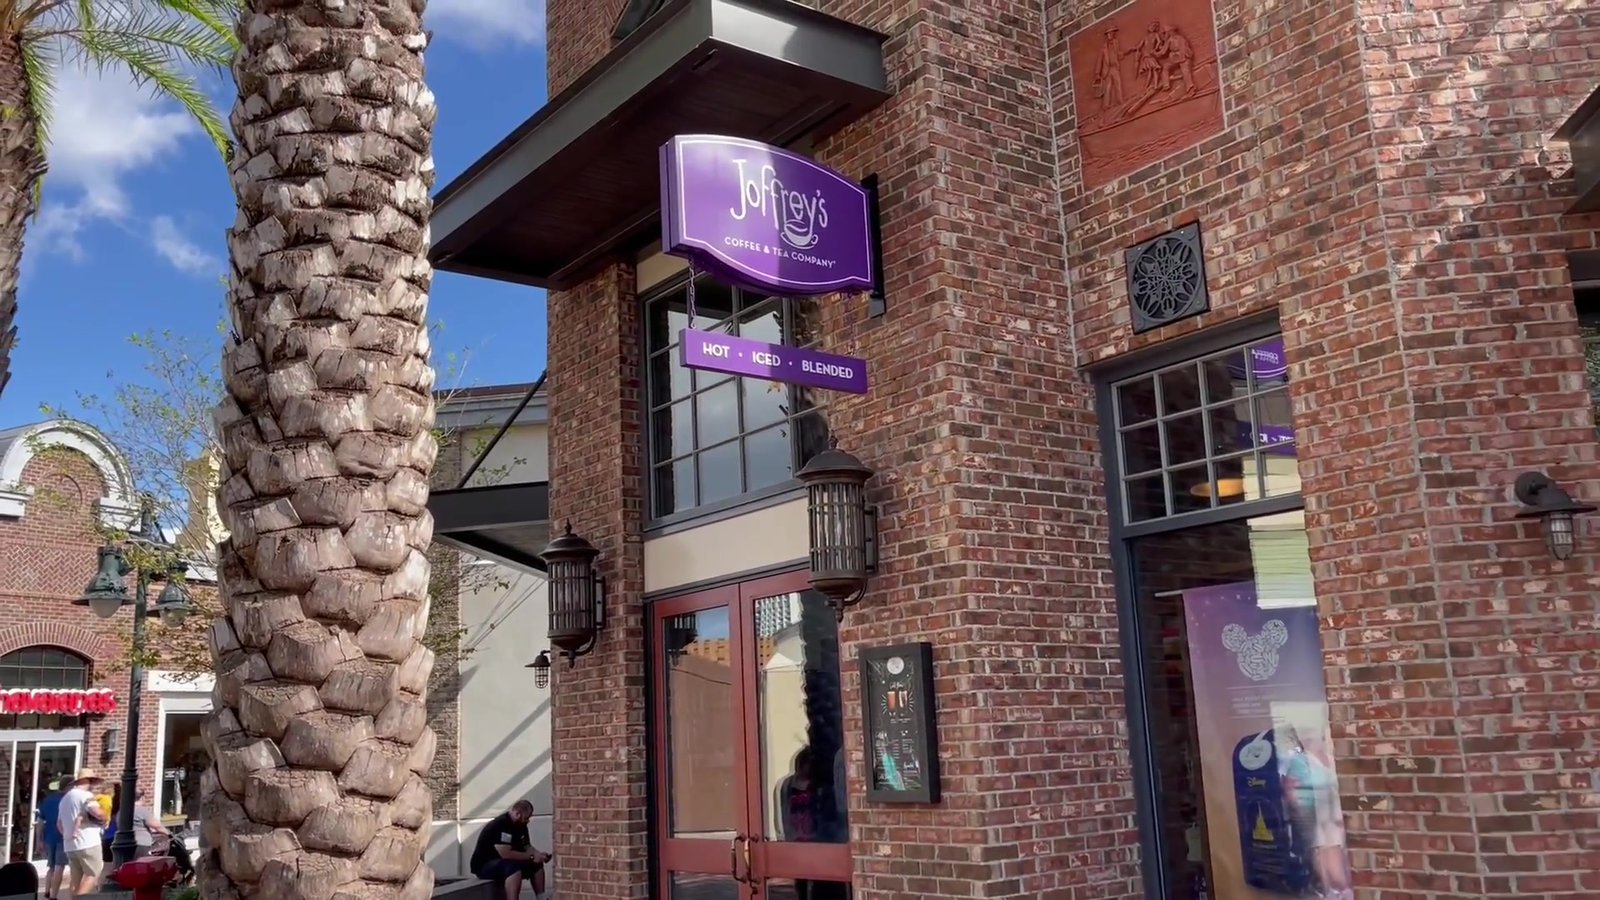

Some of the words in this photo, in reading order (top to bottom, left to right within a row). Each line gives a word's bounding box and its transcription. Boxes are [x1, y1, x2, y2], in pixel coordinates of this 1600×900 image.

[730, 159, 828, 230] Joffrey's
[724, 236, 761, 252] COFFEE
[763, 245, 770, 254] &
[772, 247, 789, 258] TEA
[703, 341, 730, 358] HOT
[752, 351, 781, 367] ICED
[801, 360, 853, 379] BLENDED
